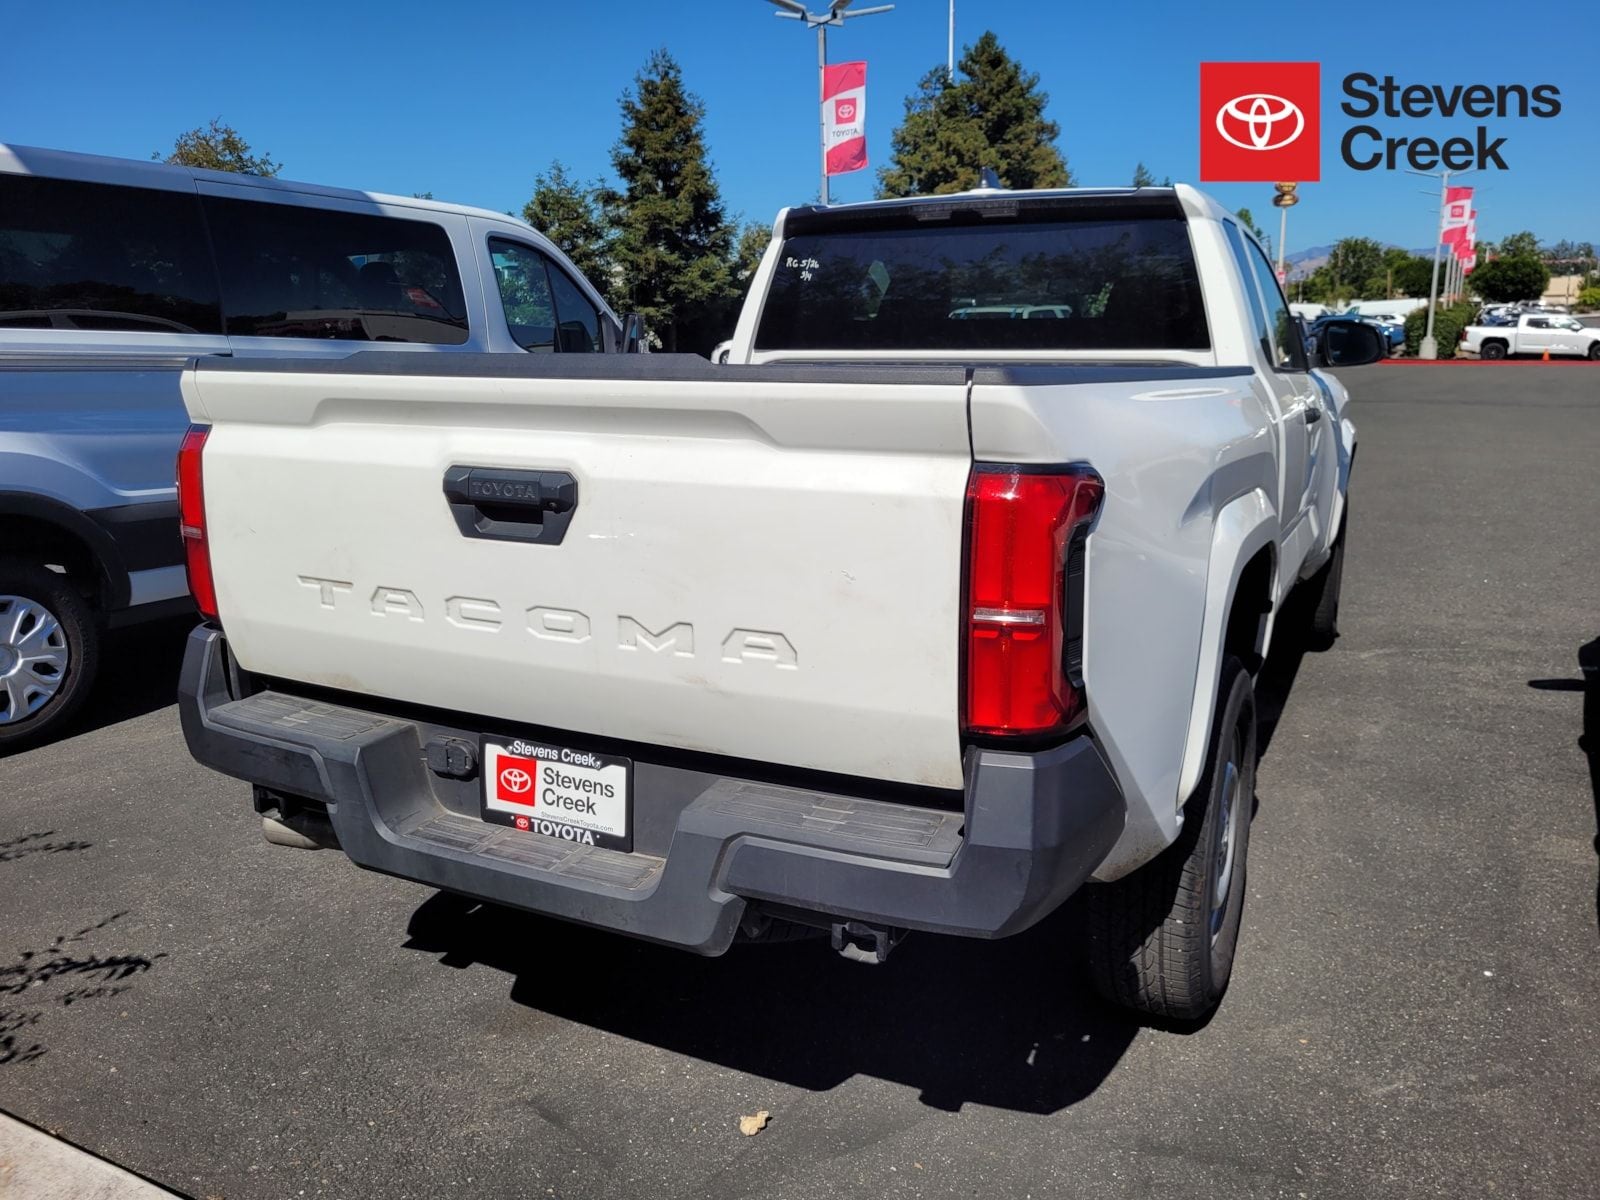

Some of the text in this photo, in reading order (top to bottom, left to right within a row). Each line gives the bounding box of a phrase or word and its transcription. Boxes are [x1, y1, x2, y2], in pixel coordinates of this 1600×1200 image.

[832, 127, 858, 138] TOYOTA
[472, 480, 536, 498] TOYOTA
[297, 574, 799, 670] TACOMA
[513, 740, 595, 767] Stevens Creek
[543, 767, 615, 798] Stevens
[542, 788, 597, 816] Creek
[531, 818, 595, 845] TOYOTA
[541, 811, 614, 833] StevensCreekToyota.com
